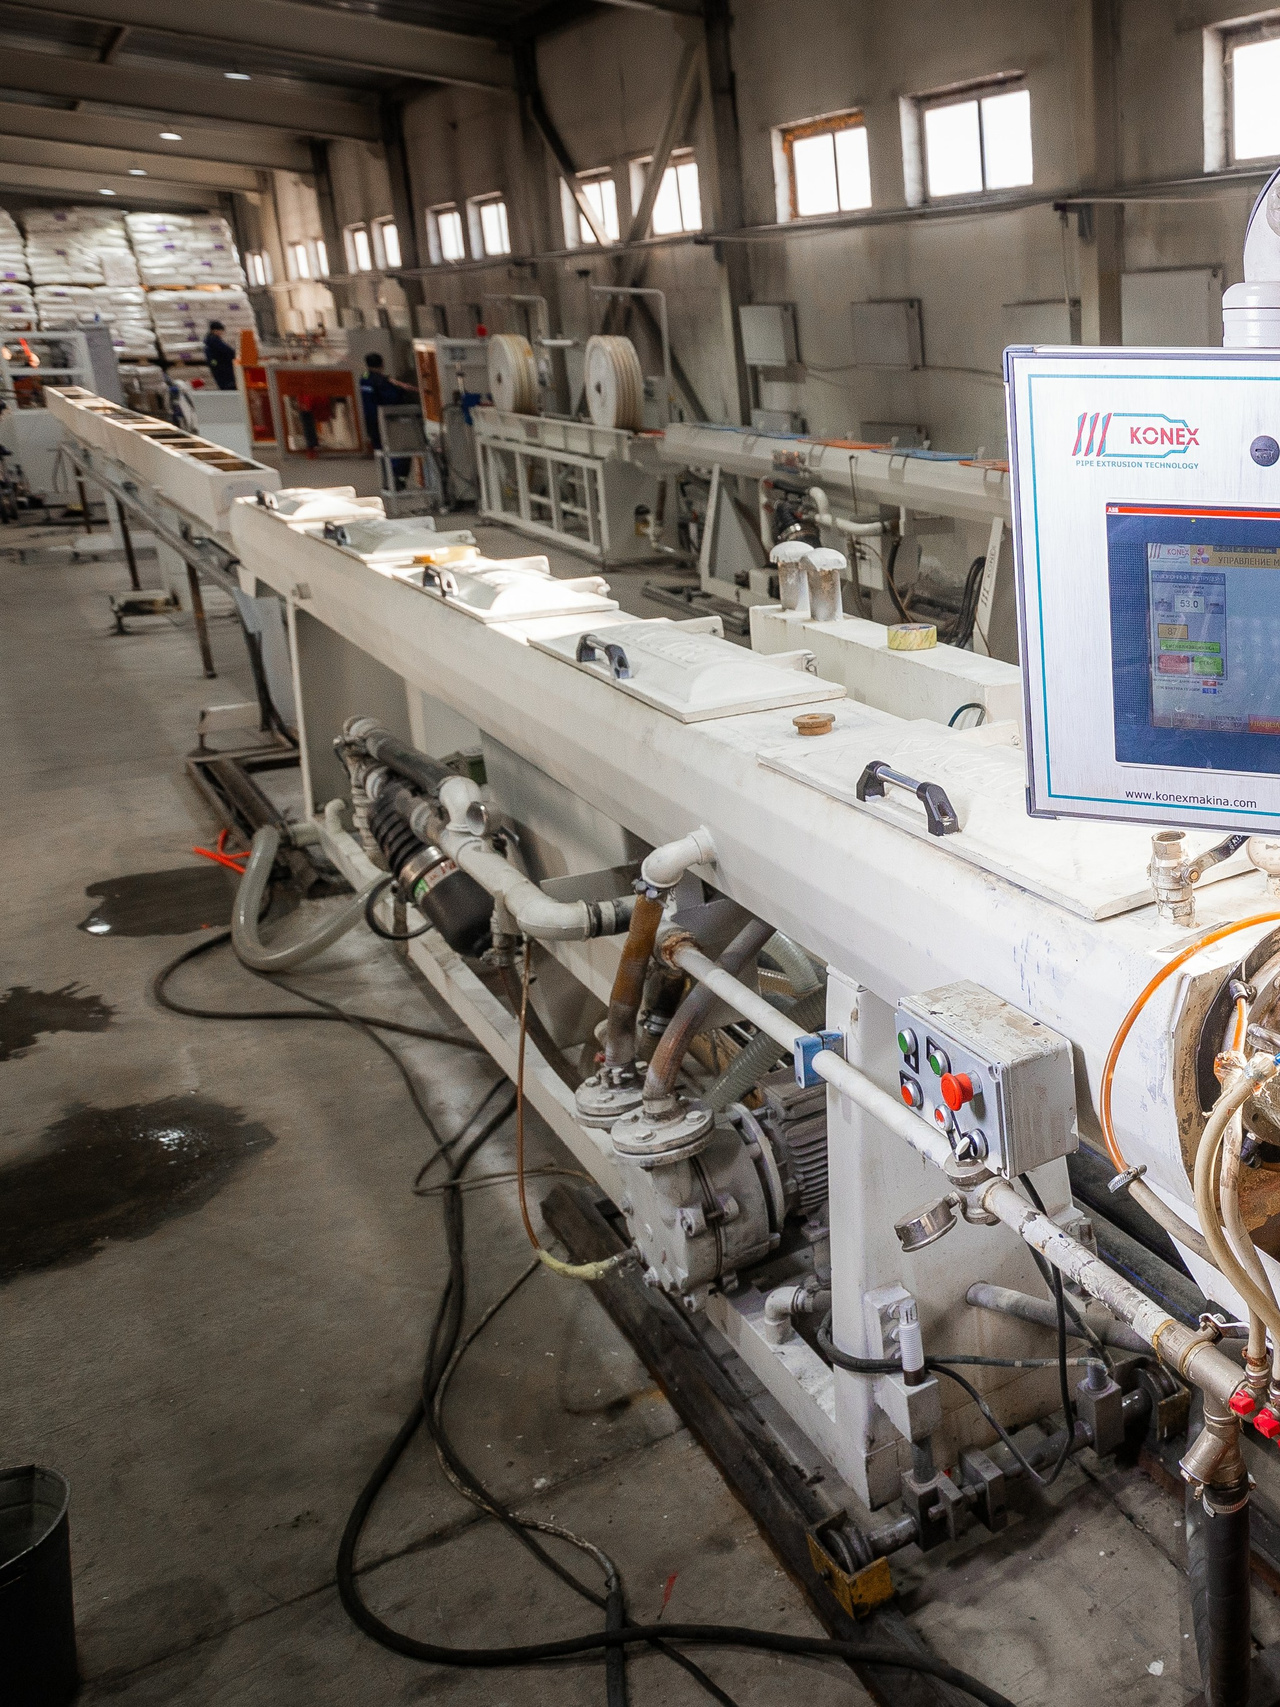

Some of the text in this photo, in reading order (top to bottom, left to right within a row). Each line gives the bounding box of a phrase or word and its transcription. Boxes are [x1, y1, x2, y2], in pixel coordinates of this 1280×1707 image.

[1130, 427, 1200, 446] KONEX
[1146, 462, 1199, 470] TECHNOLOGY
[1167, 548, 1190, 556] KONEX
[1218, 557, 1271, 566] УПРАВЛЕНИЕ
[1180, 600, 1199, 609] 53.0
[1167, 627, 1178, 636] 87
[1125, 790, 1257, 808] www.konexmakina.com
